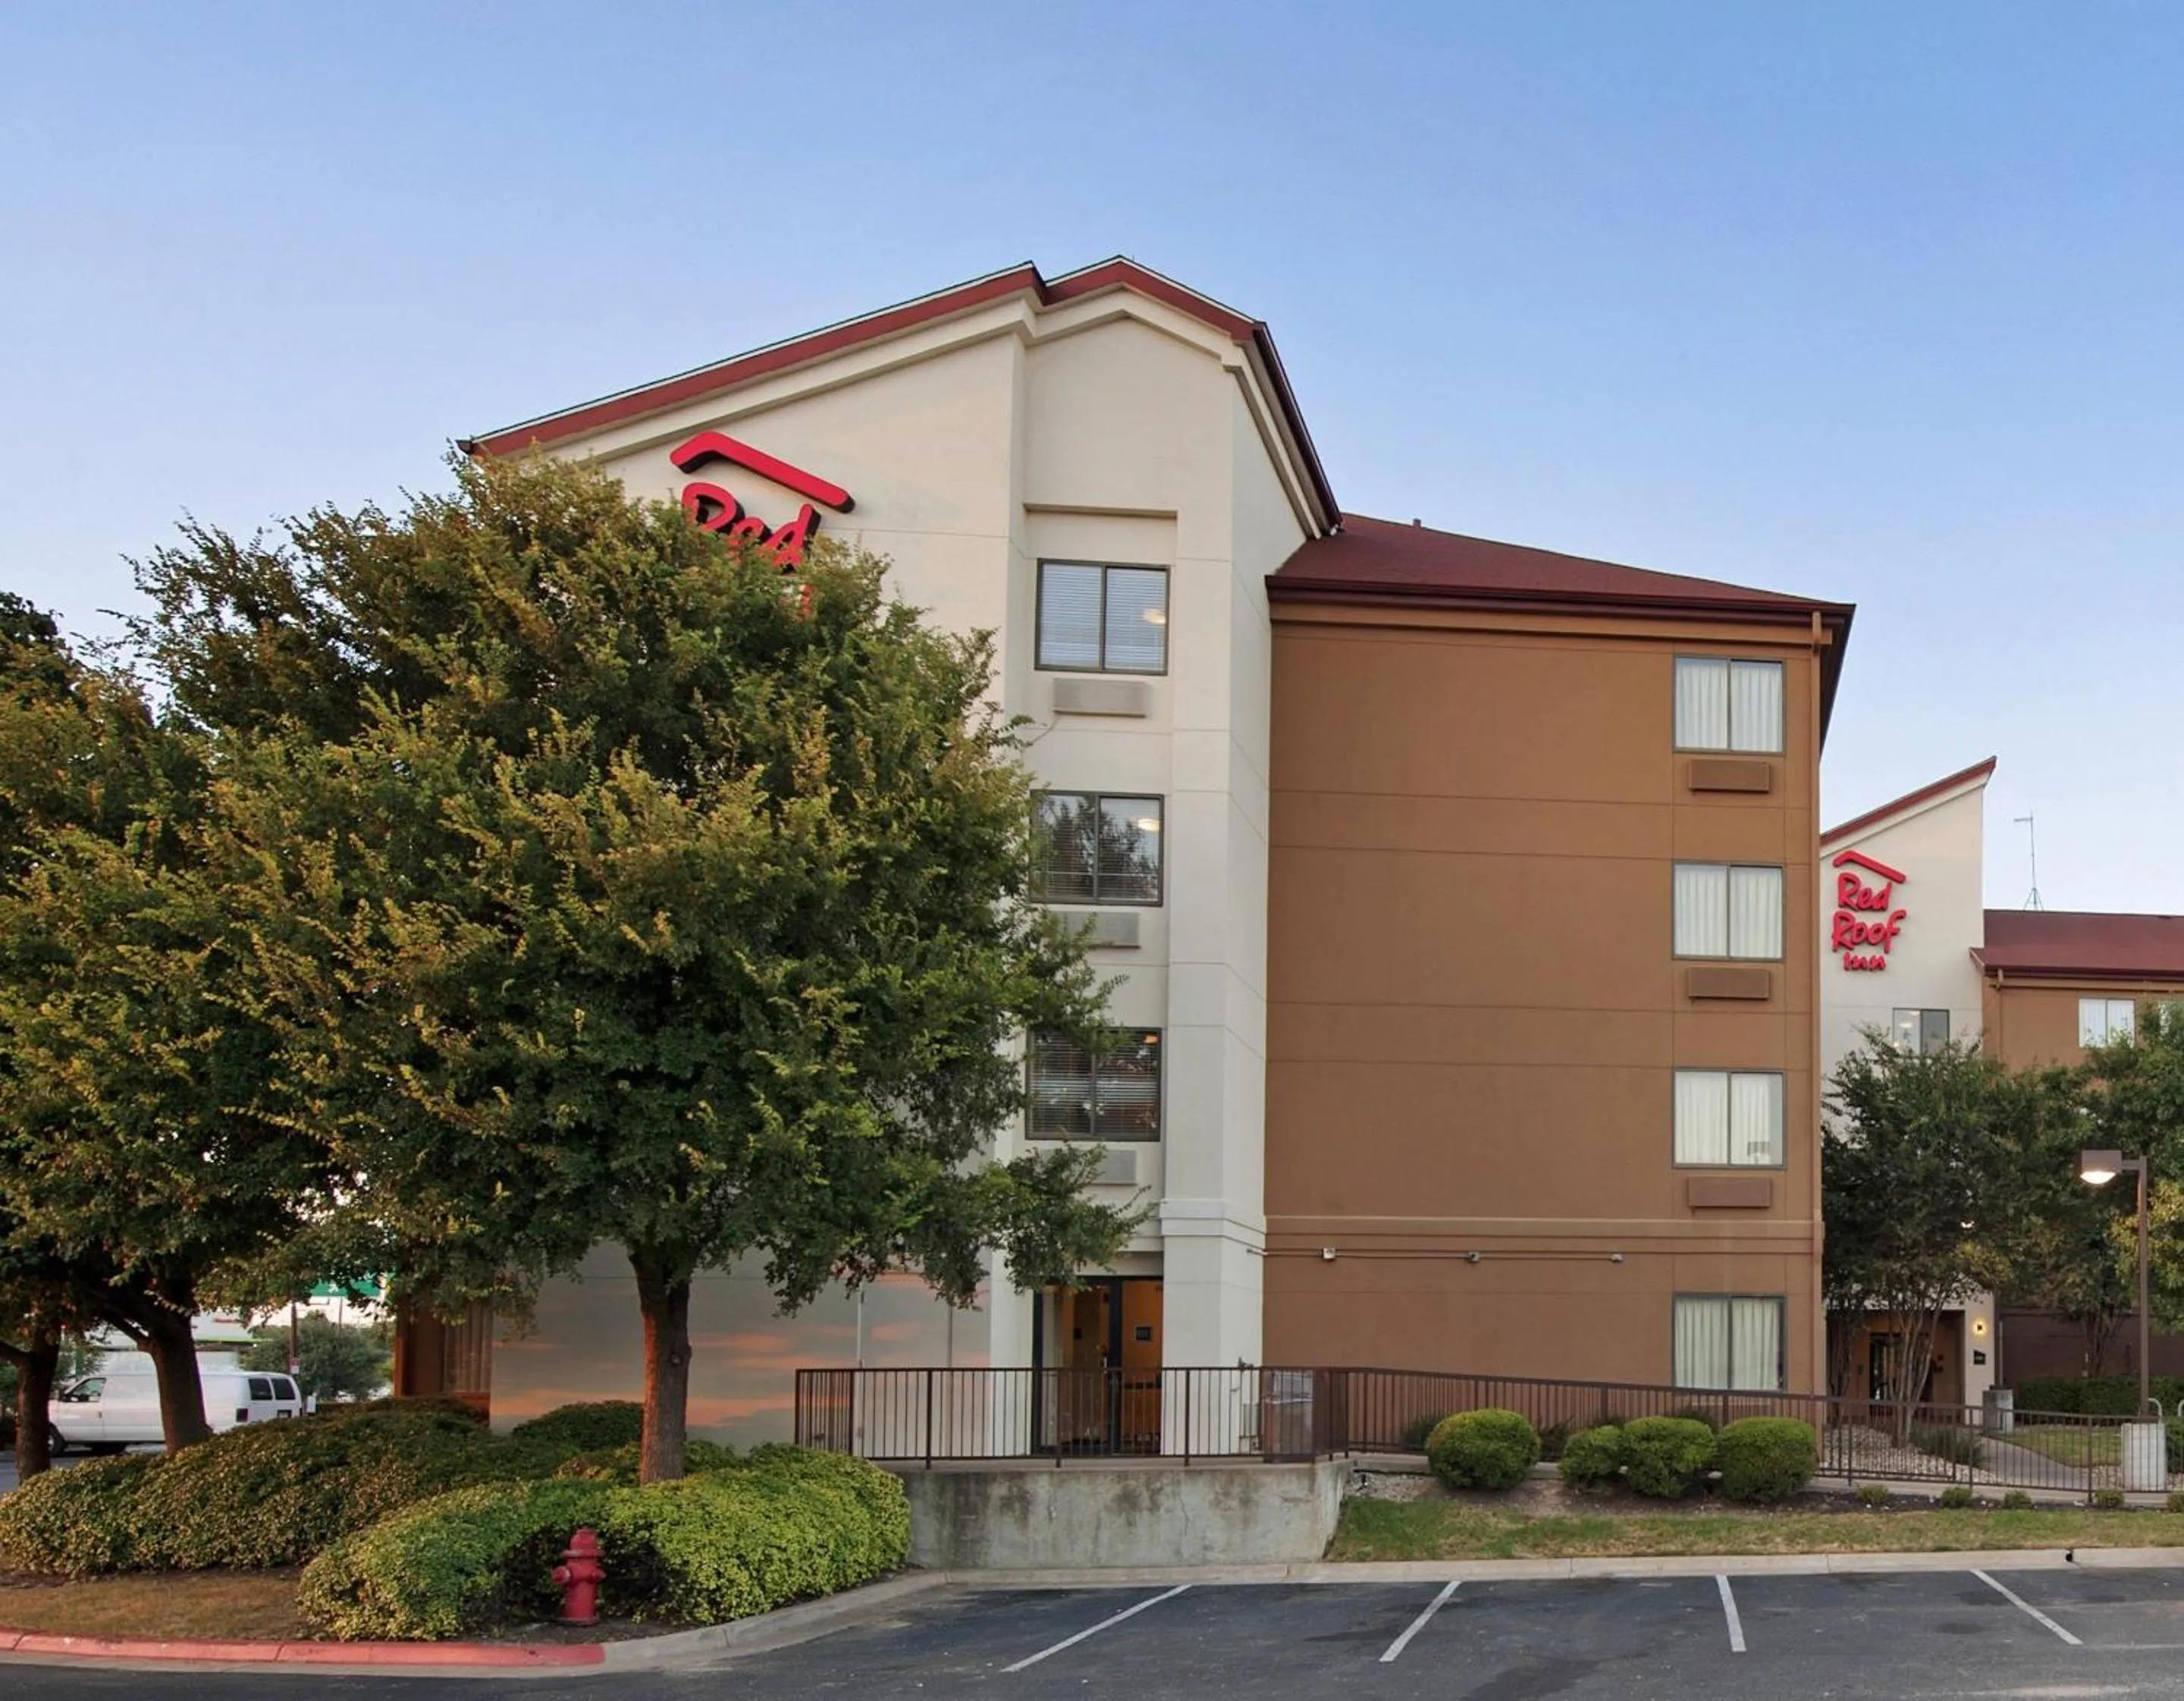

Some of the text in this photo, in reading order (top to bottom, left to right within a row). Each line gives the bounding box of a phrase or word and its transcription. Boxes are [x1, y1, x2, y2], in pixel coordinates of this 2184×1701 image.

[1838, 872, 1892, 912] Red
[1831, 909, 1907, 953] Roof
[1843, 952, 1886, 971] Inn
